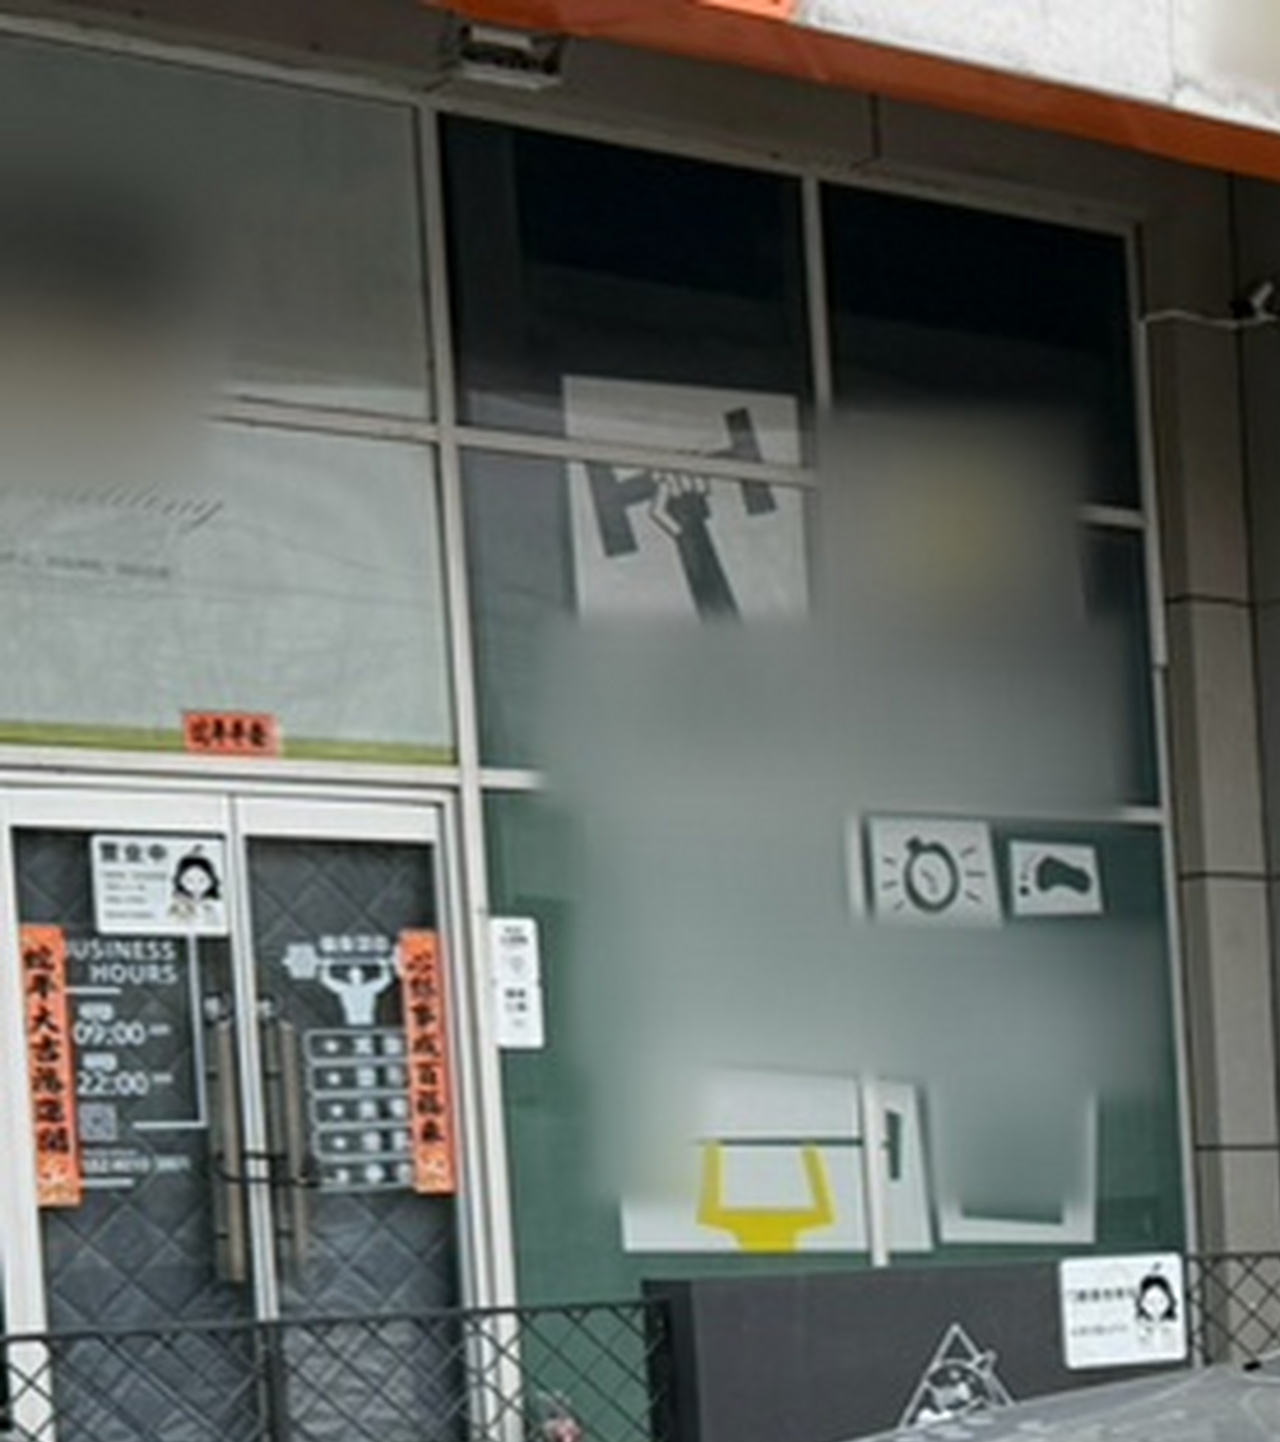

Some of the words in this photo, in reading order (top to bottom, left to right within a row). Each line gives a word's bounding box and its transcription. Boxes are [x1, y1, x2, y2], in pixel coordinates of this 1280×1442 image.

[66, 940, 177, 960] USINESS
[90, 963, 178, 985] HOURS
[73, 1021, 146, 1046] 09:00
[77, 1072, 150, 1096] 22:00
